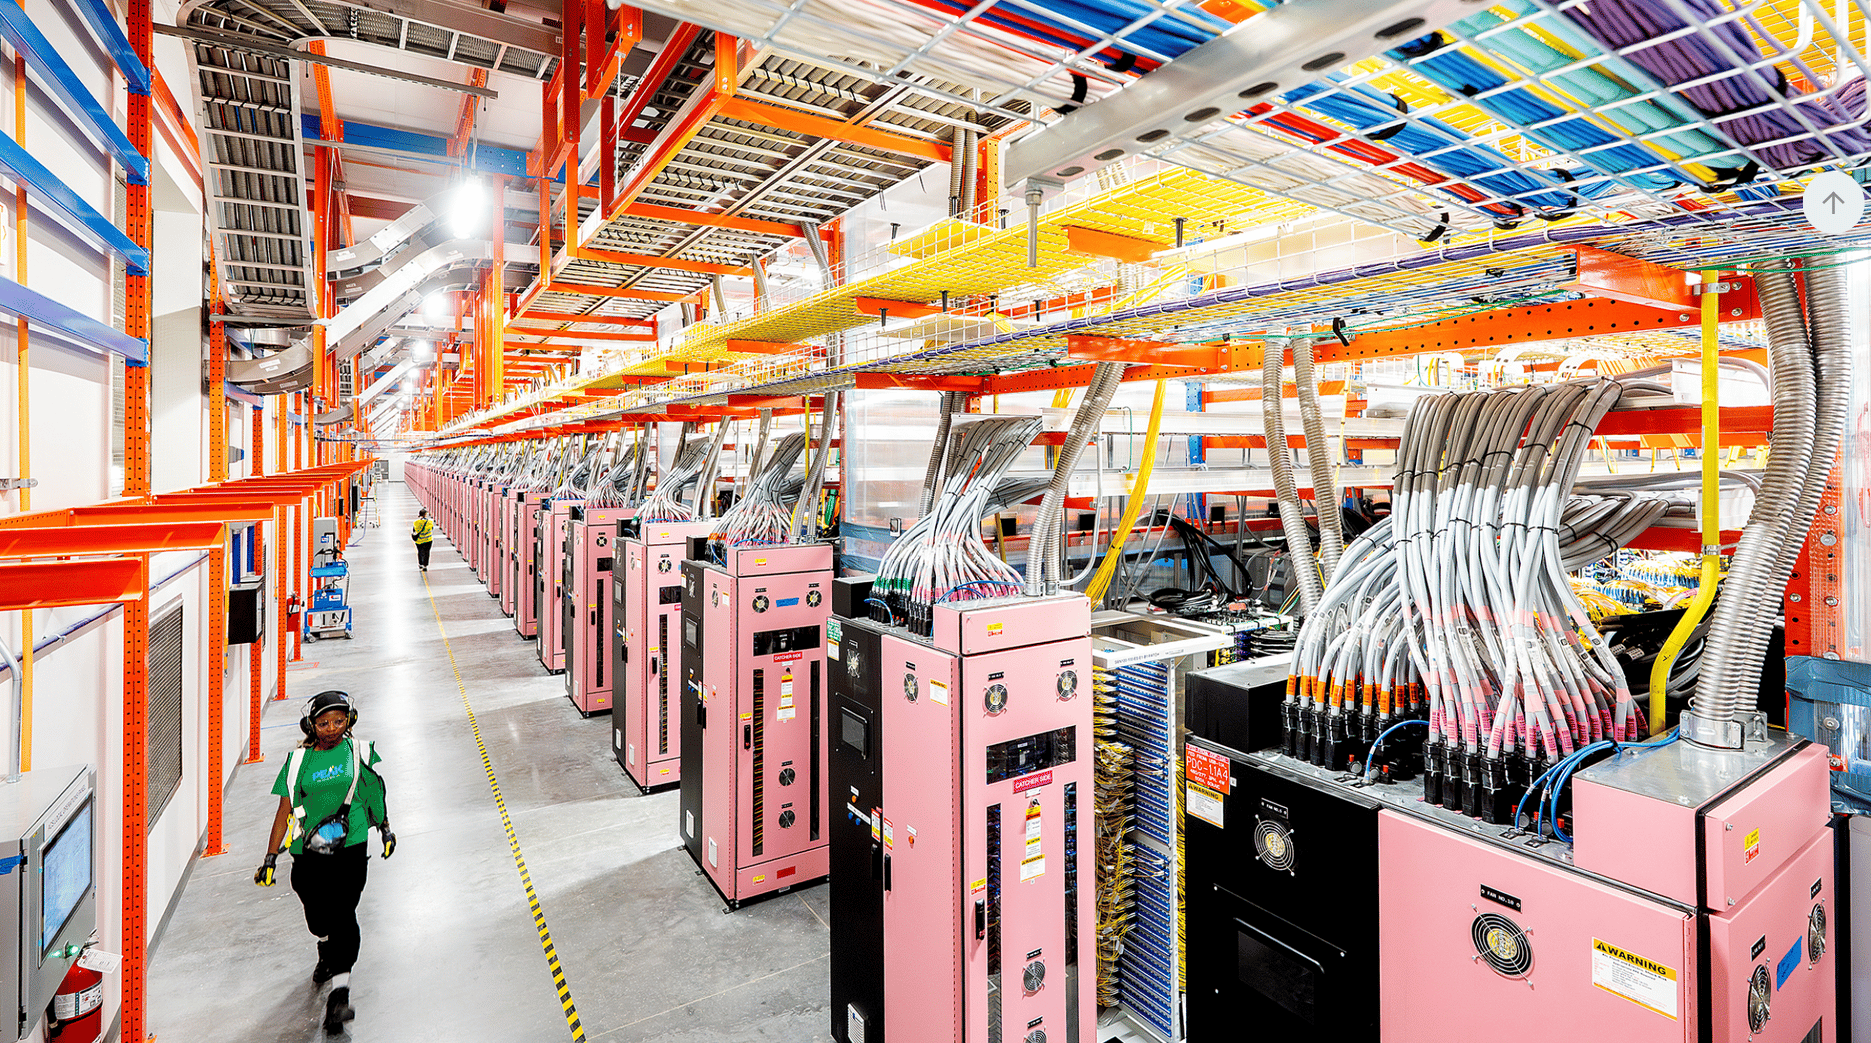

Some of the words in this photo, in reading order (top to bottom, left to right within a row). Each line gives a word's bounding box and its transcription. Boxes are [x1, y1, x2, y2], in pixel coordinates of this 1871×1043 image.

[312, 764, 344, 781] PEAK
[1016, 777, 1039, 789] CATCHER
[1040, 774, 1052, 782] SIDE
[1192, 785, 1219, 800] WARNING
[1487, 891, 1497, 899] FAN
[1608, 946, 1667, 975] WARNING
